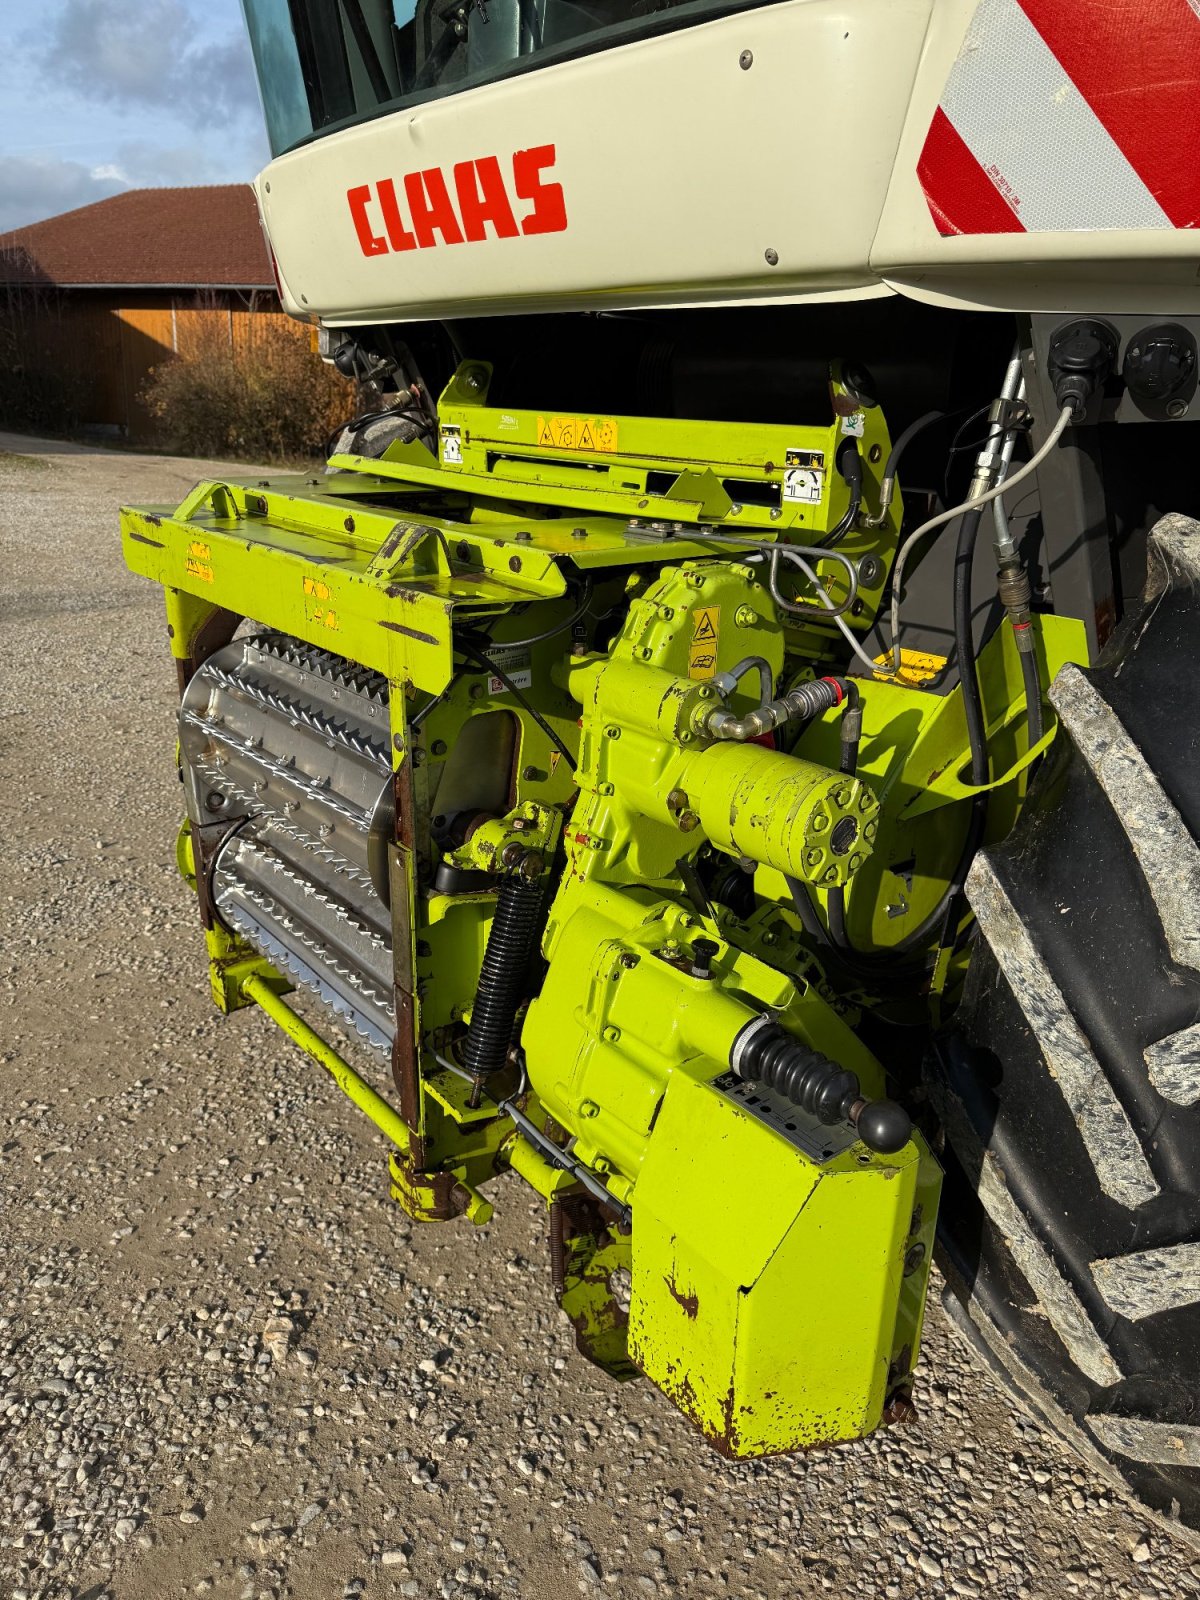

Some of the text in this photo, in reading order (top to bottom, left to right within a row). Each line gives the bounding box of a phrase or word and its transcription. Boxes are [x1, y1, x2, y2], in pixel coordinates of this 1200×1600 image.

[347, 144, 567, 257] CLAAS
[990, 164, 1001, 177] DIN
[998, 175, 1013, 194] 30710
[1012, 195, 1021, 206] 3M
